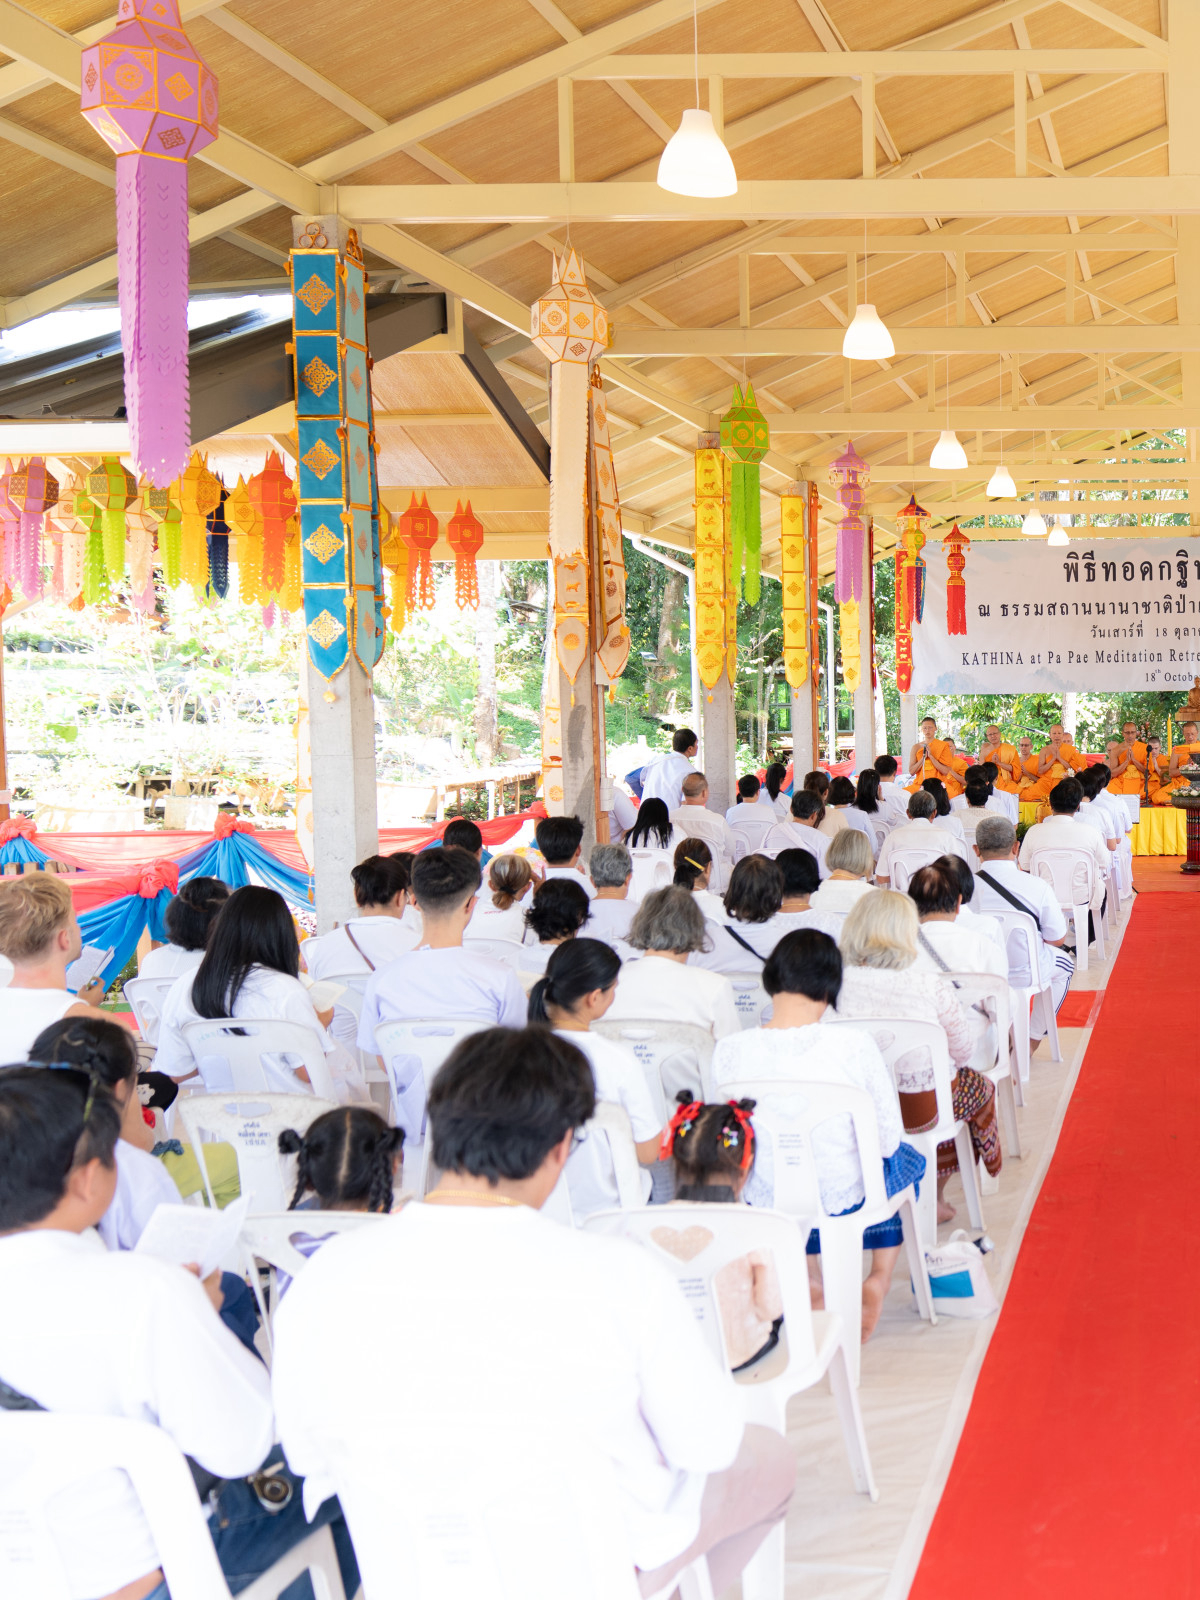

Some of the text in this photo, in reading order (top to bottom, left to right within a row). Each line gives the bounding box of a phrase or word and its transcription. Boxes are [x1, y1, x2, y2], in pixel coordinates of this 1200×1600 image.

[977, 603, 991, 618] ณ
[1090, 619, 1144, 639] วันเสาร์ที่
[1155, 627, 1168, 638] 18
[961, 651, 1024, 666] KATHINA
[1030, 653, 1042, 665] at
[1047, 650, 1062, 664] Pa
[1067, 650, 1089, 664] Pae
[1094, 648, 1163, 664] Meditation
[1145, 669, 1162, 682] 18th
